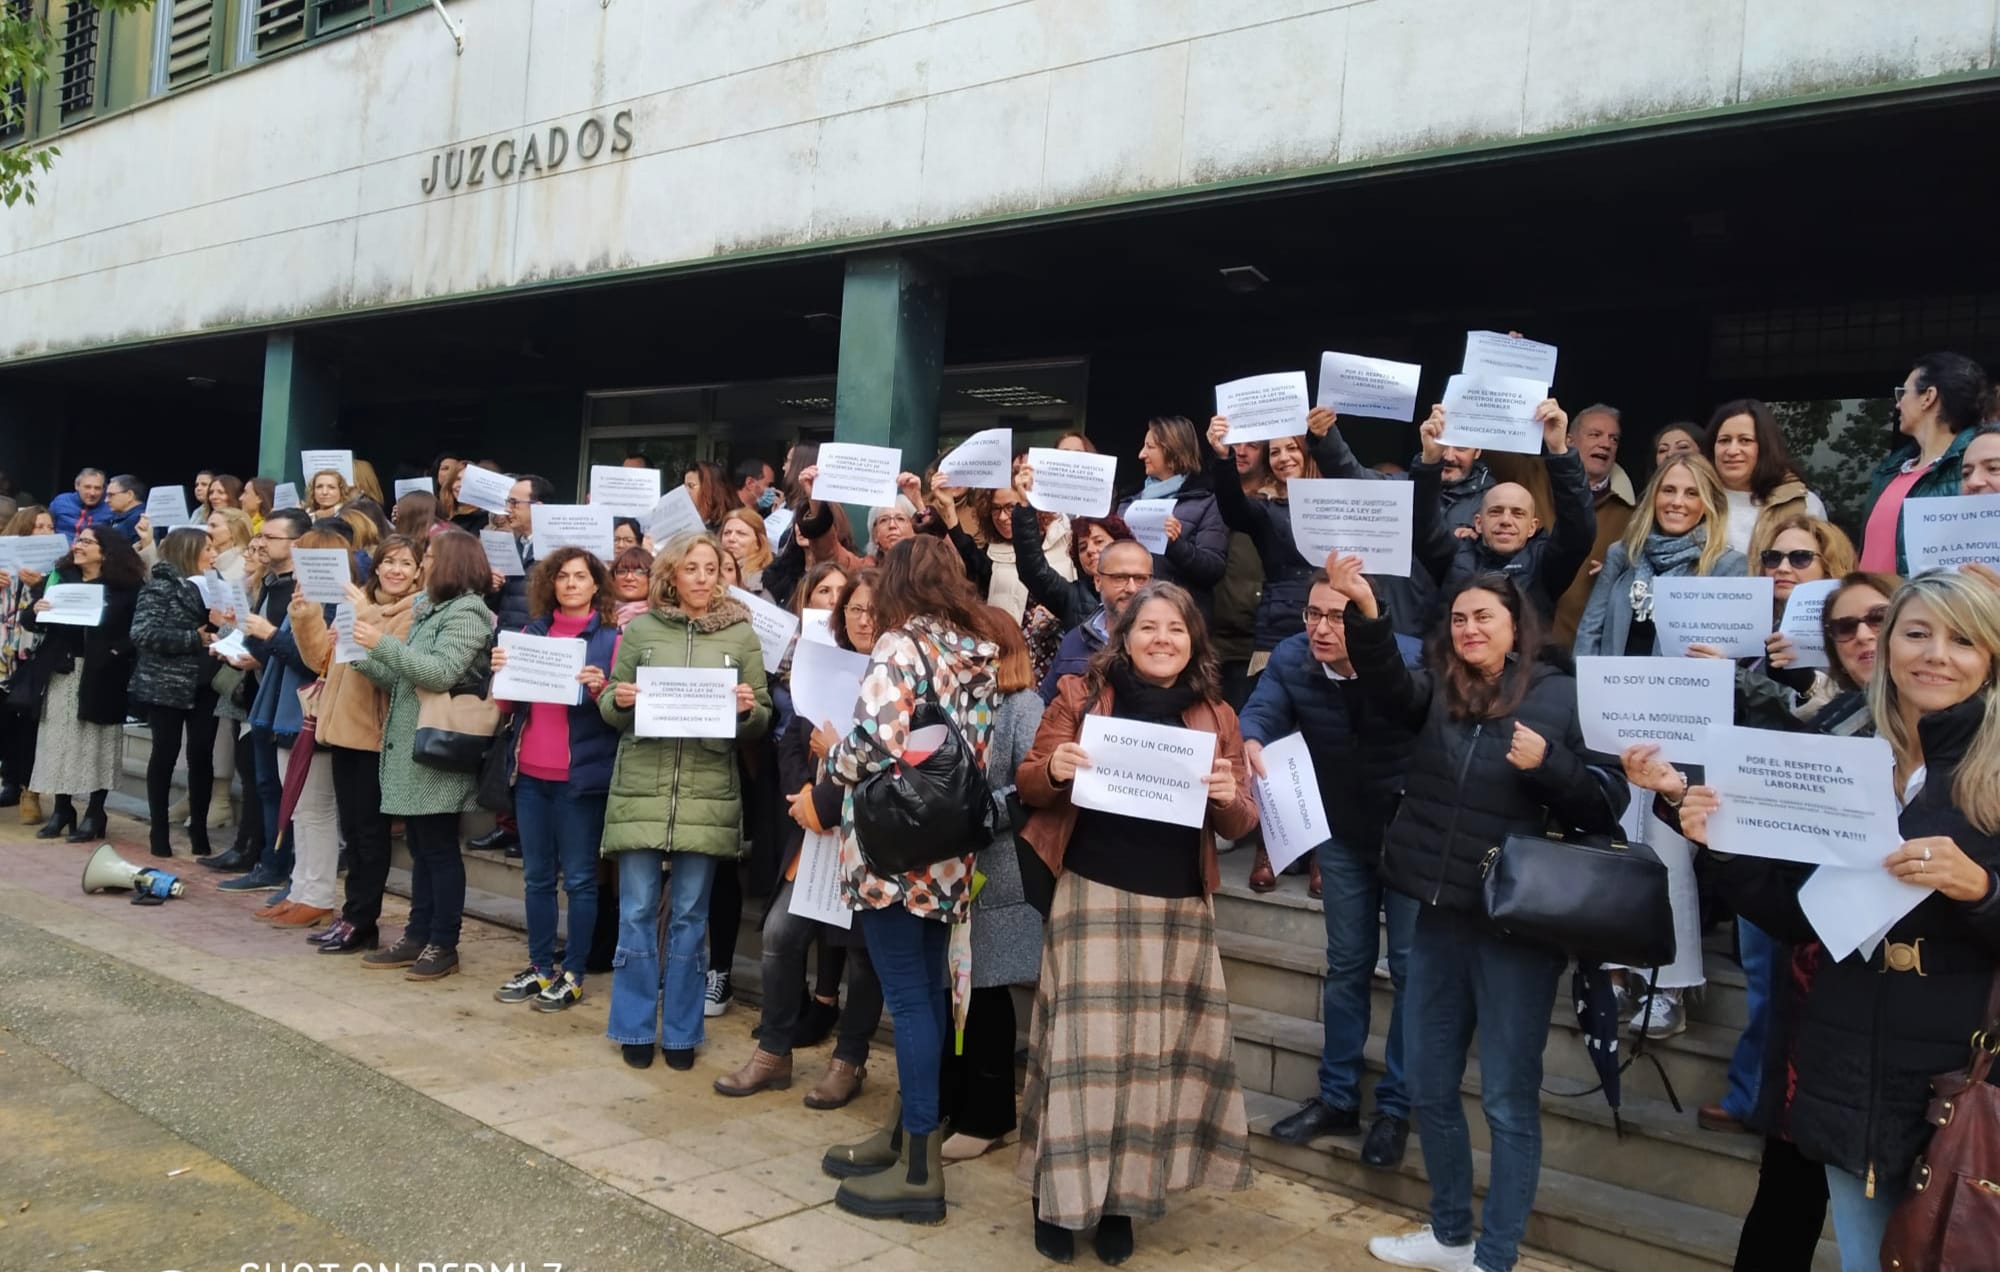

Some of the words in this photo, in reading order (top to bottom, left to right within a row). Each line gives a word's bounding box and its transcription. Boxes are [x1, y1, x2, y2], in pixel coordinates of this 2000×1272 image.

[421, 108, 633, 194] JUZGADOS
[1476, 401, 1511, 409] LABORALES
[1923, 513, 1937, 522] NO
[1939, 513, 1959, 522] SOY
[1961, 511, 1977, 520] UN
[1922, 546, 1938, 554] NO
[1950, 543, 1964, 552] LA
[1669, 591, 1683, 600] NO
[1684, 591, 1700, 601] SOY
[1701, 592, 1715, 601] UN
[1716, 592, 1753, 601] CROMO
[1668, 621, 1680, 629] NO
[1681, 621, 1687, 630] A
[1688, 621, 1699, 630] LA
[1700, 621, 1754, 631] MOVILIDAD
[1679, 635, 1739, 644] DISCRECIONAL
[1603, 675, 1621, 685] NO
[1623, 675, 1645, 685] SOY
[1648, 676, 1665, 686] UN
[1668, 676, 1710, 688] CROMO
[1602, 712, 1618, 721] NO
[1632, 712, 1646, 722] LA
[1618, 728, 1696, 742] DISCRECIONAL
[1104, 733, 1118, 744] NO
[1120, 735, 1139, 747] SOY
[1141, 738, 1155, 750] UN
[1157, 742, 1194, 756] CROMO
[1746, 755, 1767, 766] POR
[1769, 758, 1781, 767] EL
[1784, 759, 1832, 773] RESPETO
[1836, 765, 1844, 774] A
[1096, 765, 1111, 776] NO
[1113, 769, 1120, 777] A
[1122, 770, 1134, 780] LA
[1136, 773, 1190, 790] MOVILIDAD
[1738, 766, 1792, 779] NUESTROS
[1795, 772, 1854, 785] DERECHOS
[1107, 783, 1174, 803] DISCRECIONAL
[1288, 757, 1296, 770] NO
[1298, 797, 1312, 830] CROMO
[1764, 779, 1826, 794] LABORALES
